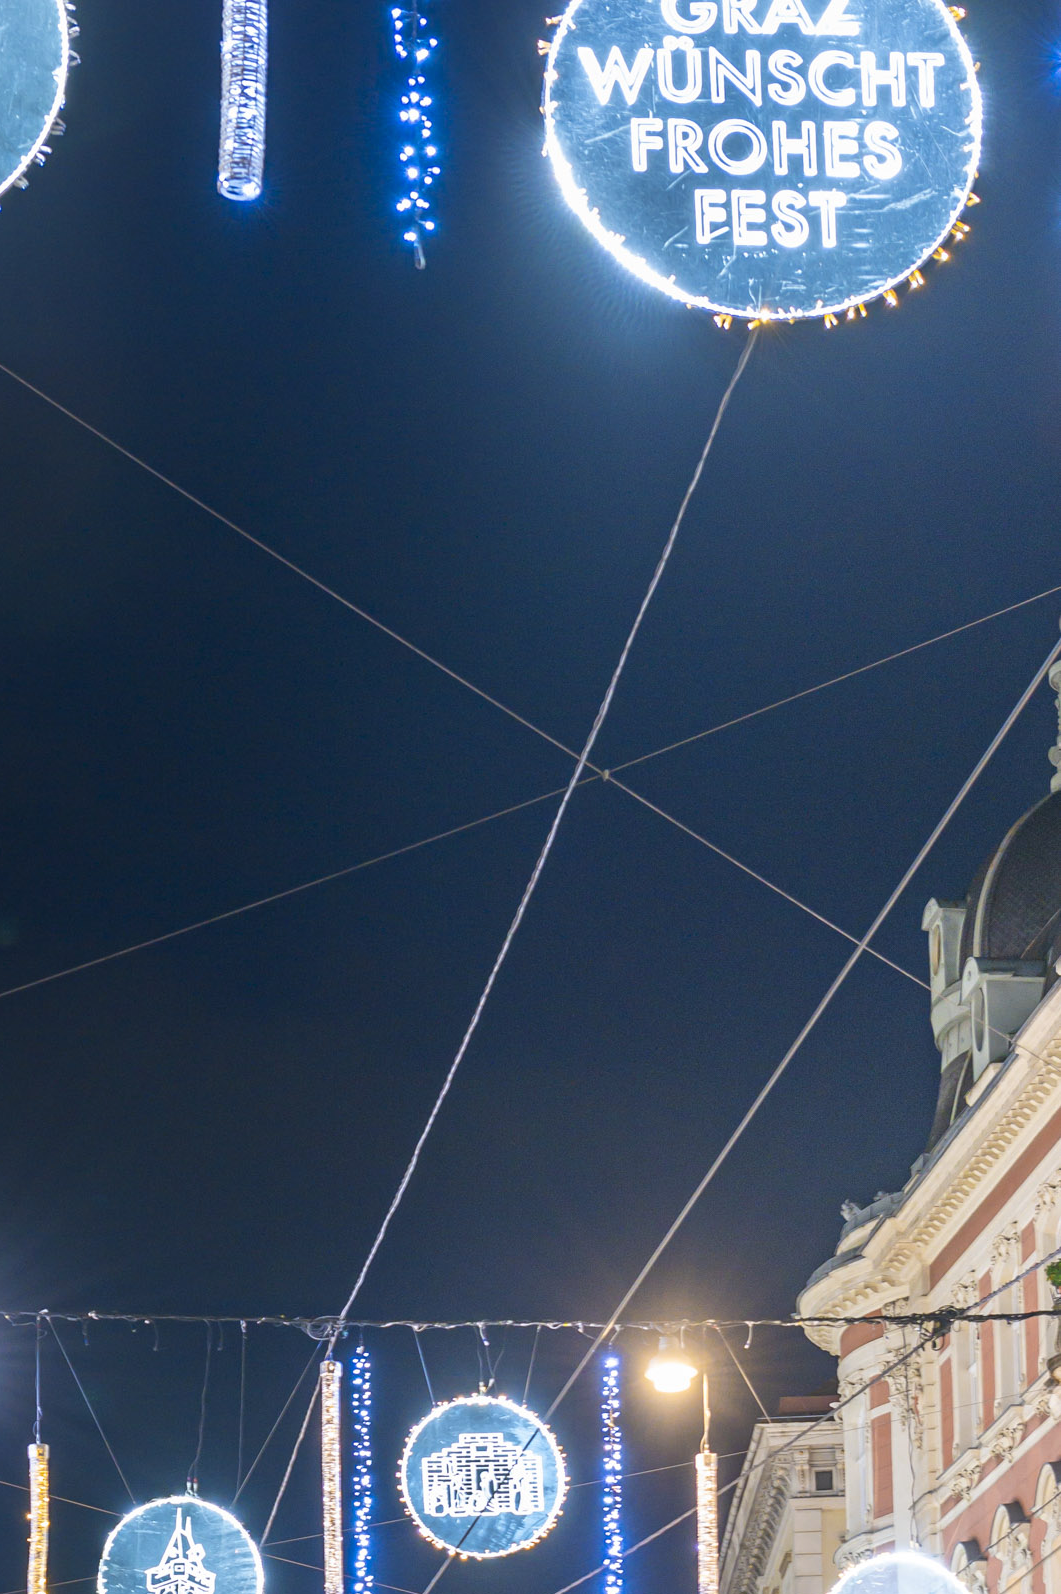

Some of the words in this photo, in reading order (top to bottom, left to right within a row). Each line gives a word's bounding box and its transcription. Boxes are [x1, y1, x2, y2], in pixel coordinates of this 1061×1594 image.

[661, 0, 860, 35] GRAZ
[577, 36, 944, 107] WÜNSCHT
[630, 117, 903, 180] FROHES
[694, 189, 848, 249] FEST
